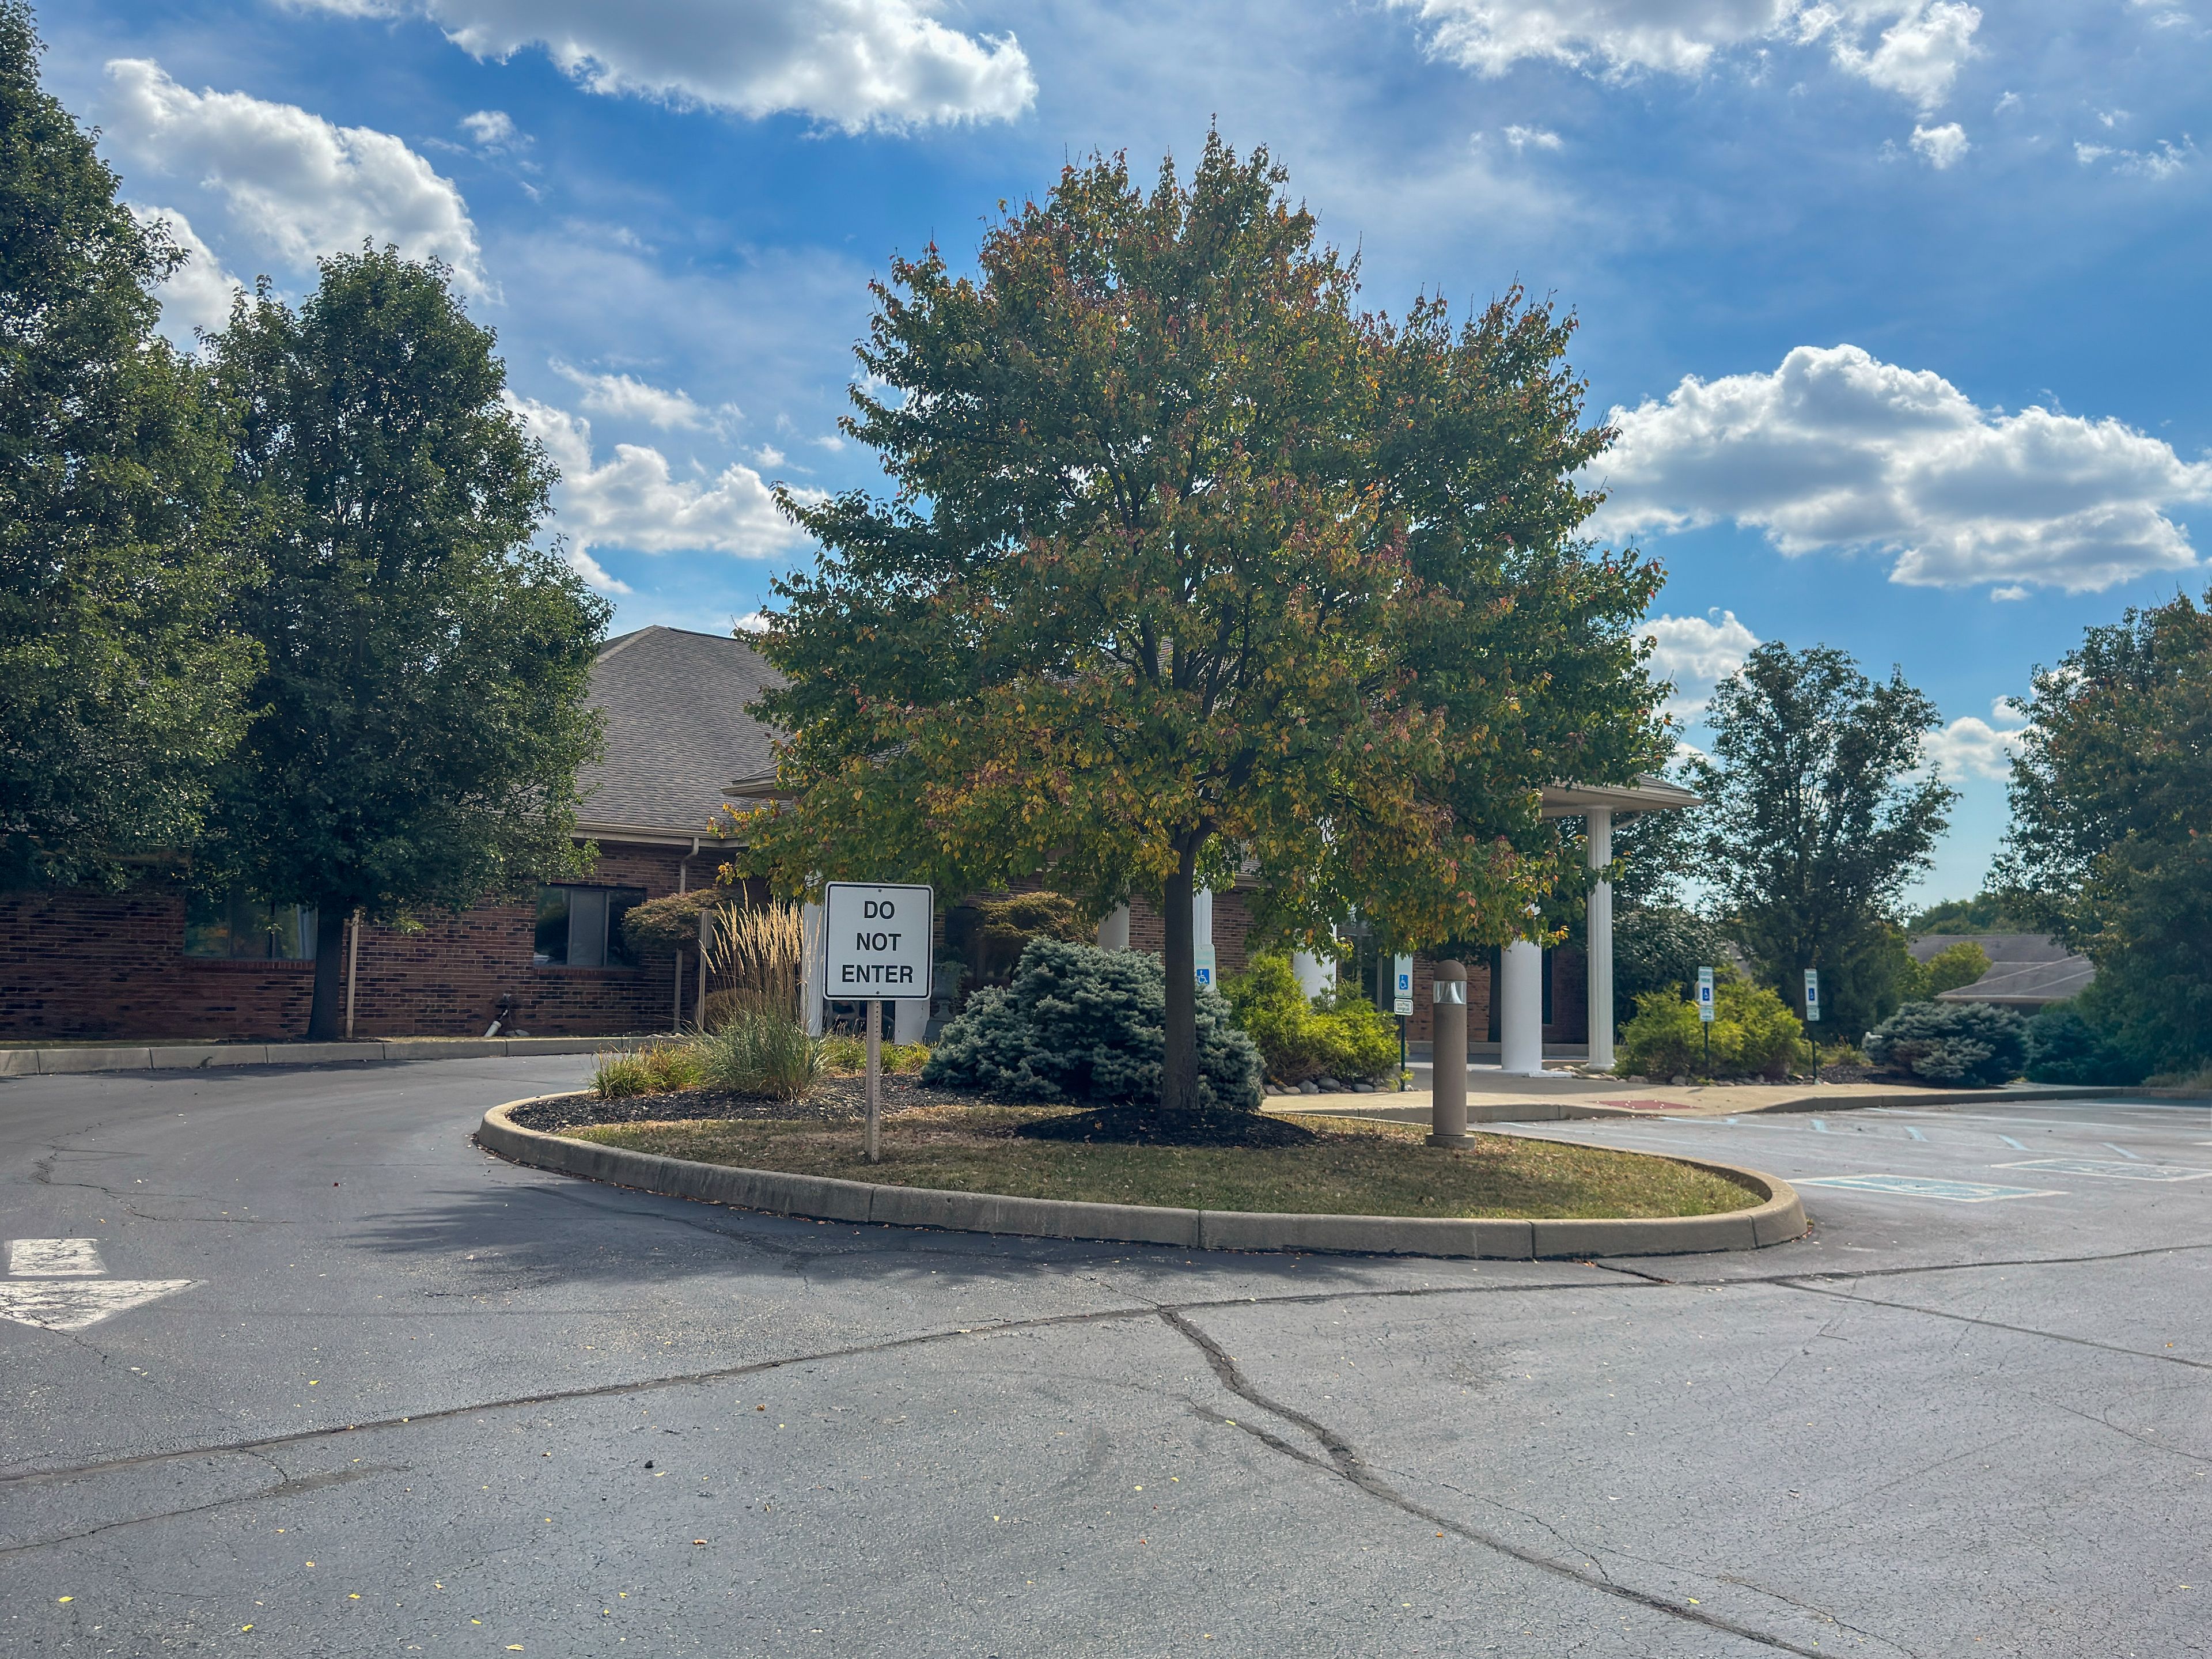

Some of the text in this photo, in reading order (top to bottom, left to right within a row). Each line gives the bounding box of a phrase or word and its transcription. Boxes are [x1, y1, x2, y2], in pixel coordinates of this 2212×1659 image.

[864, 900, 895, 919] DO
[856, 932, 902, 951] NOT
[842, 964, 913, 983] ENTER
